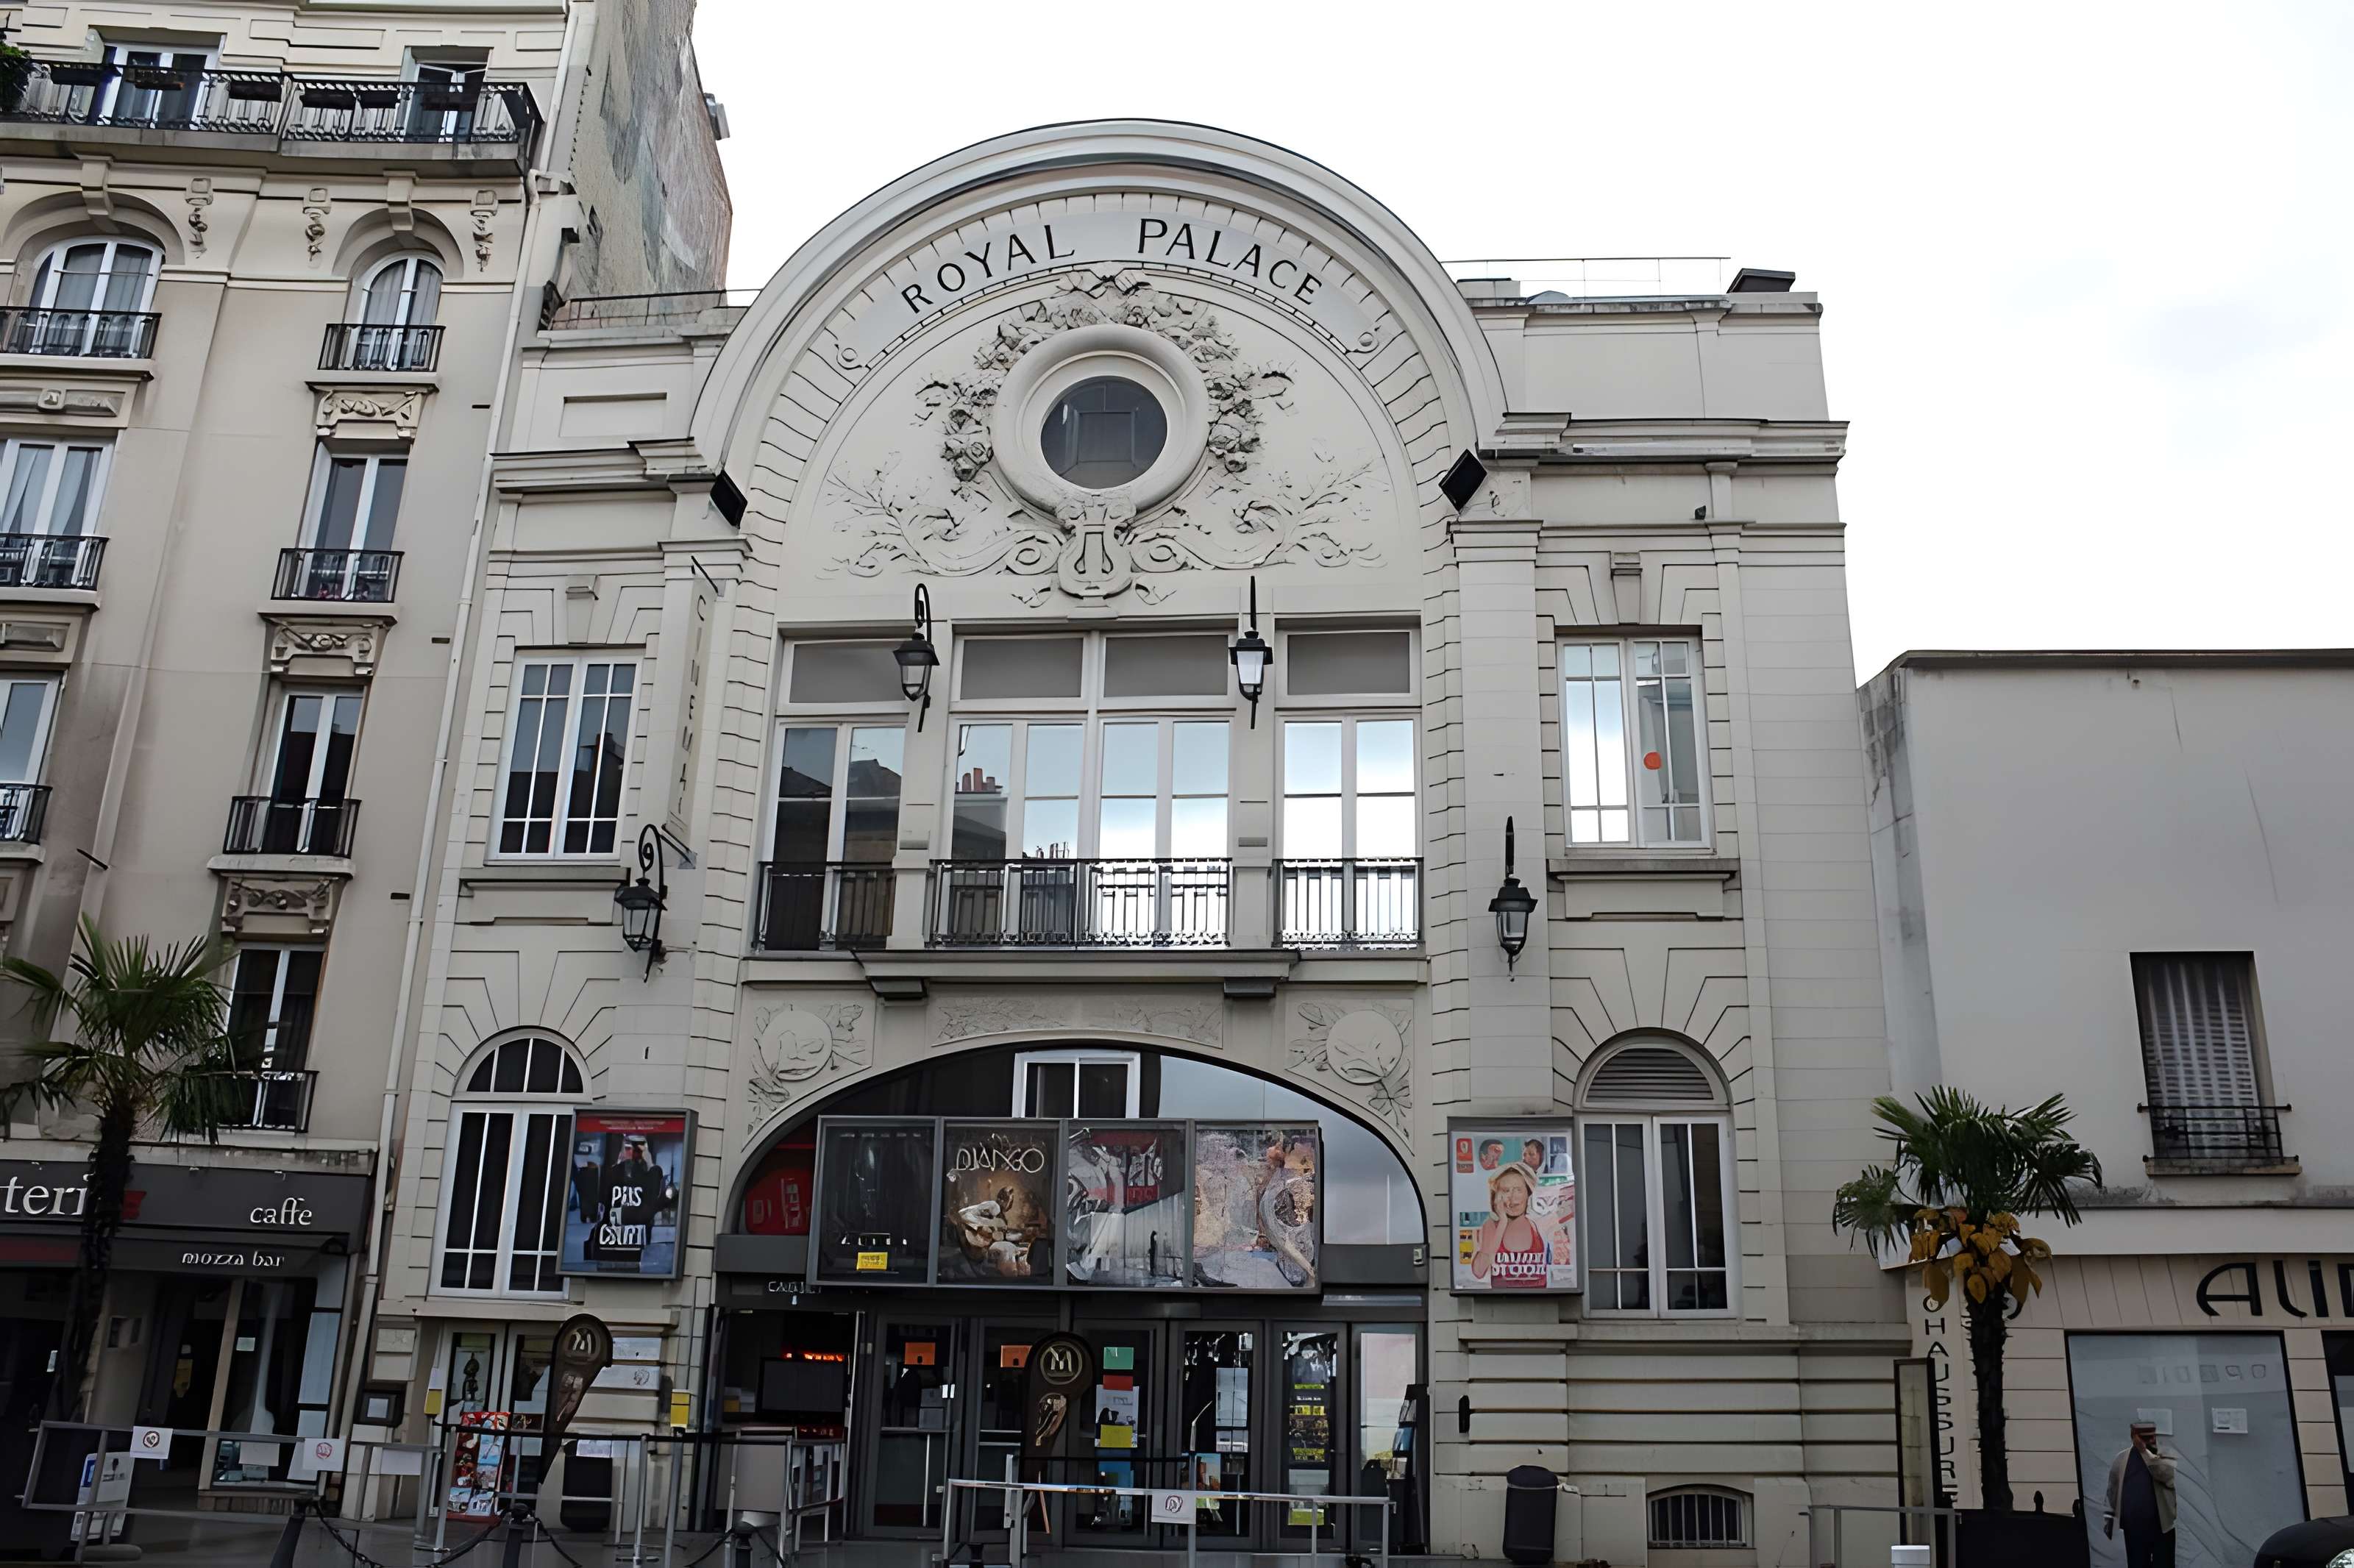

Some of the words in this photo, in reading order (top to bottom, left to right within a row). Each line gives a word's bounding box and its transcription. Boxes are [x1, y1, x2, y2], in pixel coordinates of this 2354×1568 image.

[901, 224, 1075, 313] ROYAL
[1138, 218, 1323, 305] PALACE
[252, 1250, 285, 1267] bar
